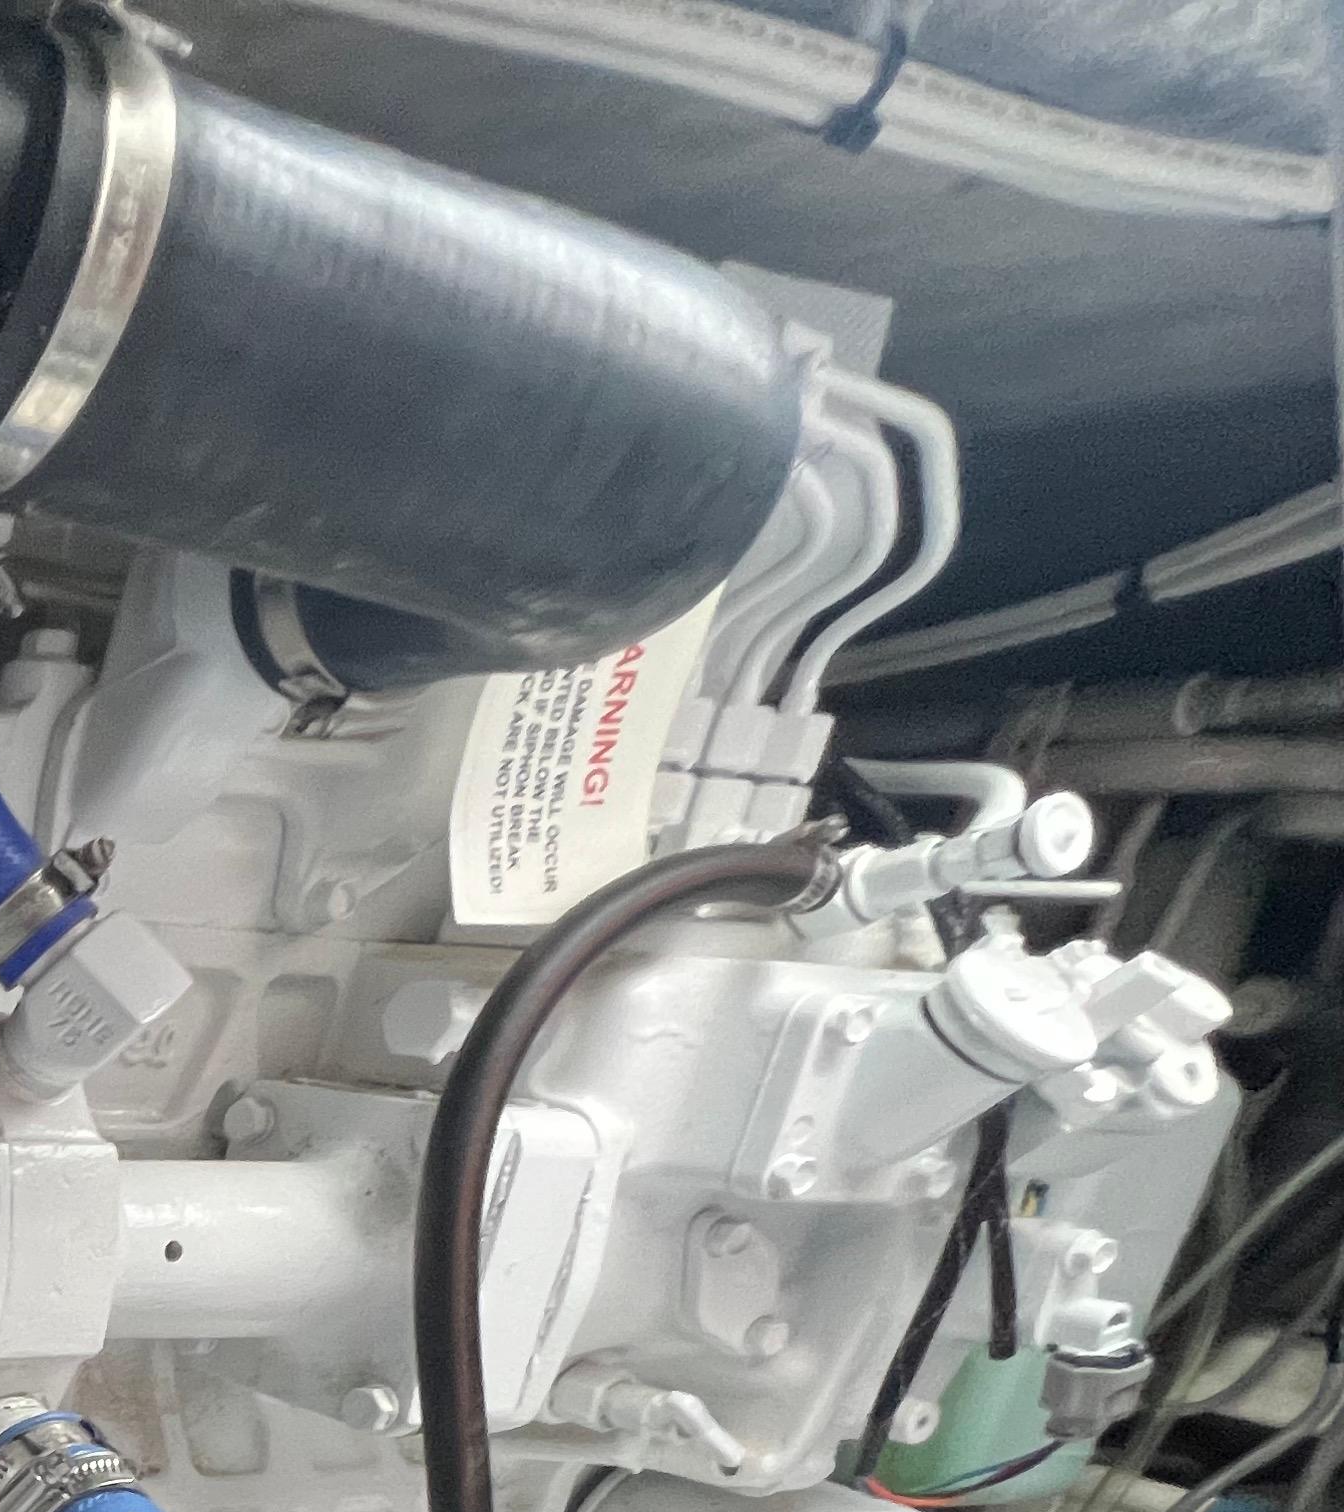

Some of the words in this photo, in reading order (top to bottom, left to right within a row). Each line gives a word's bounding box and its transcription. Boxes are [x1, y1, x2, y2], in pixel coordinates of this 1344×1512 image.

[514, 675, 535, 705] CK
[535, 699, 548, 714] IF
[550, 670, 578, 721] NTED
[503, 712, 523, 752] ARE
[557, 679, 593, 766] DAMAGE
[579, 645, 646, 807] ARNING!
[493, 760, 513, 799] NOT
[513, 723, 540, 797] SIPHON
[532, 728, 559, 800] BELOW
[547, 772, 569, 819] WILL
[506, 805, 523, 871] BREAK
[528, 809, 543, 843] THE
[543, 824, 560, 893] OCCUR
